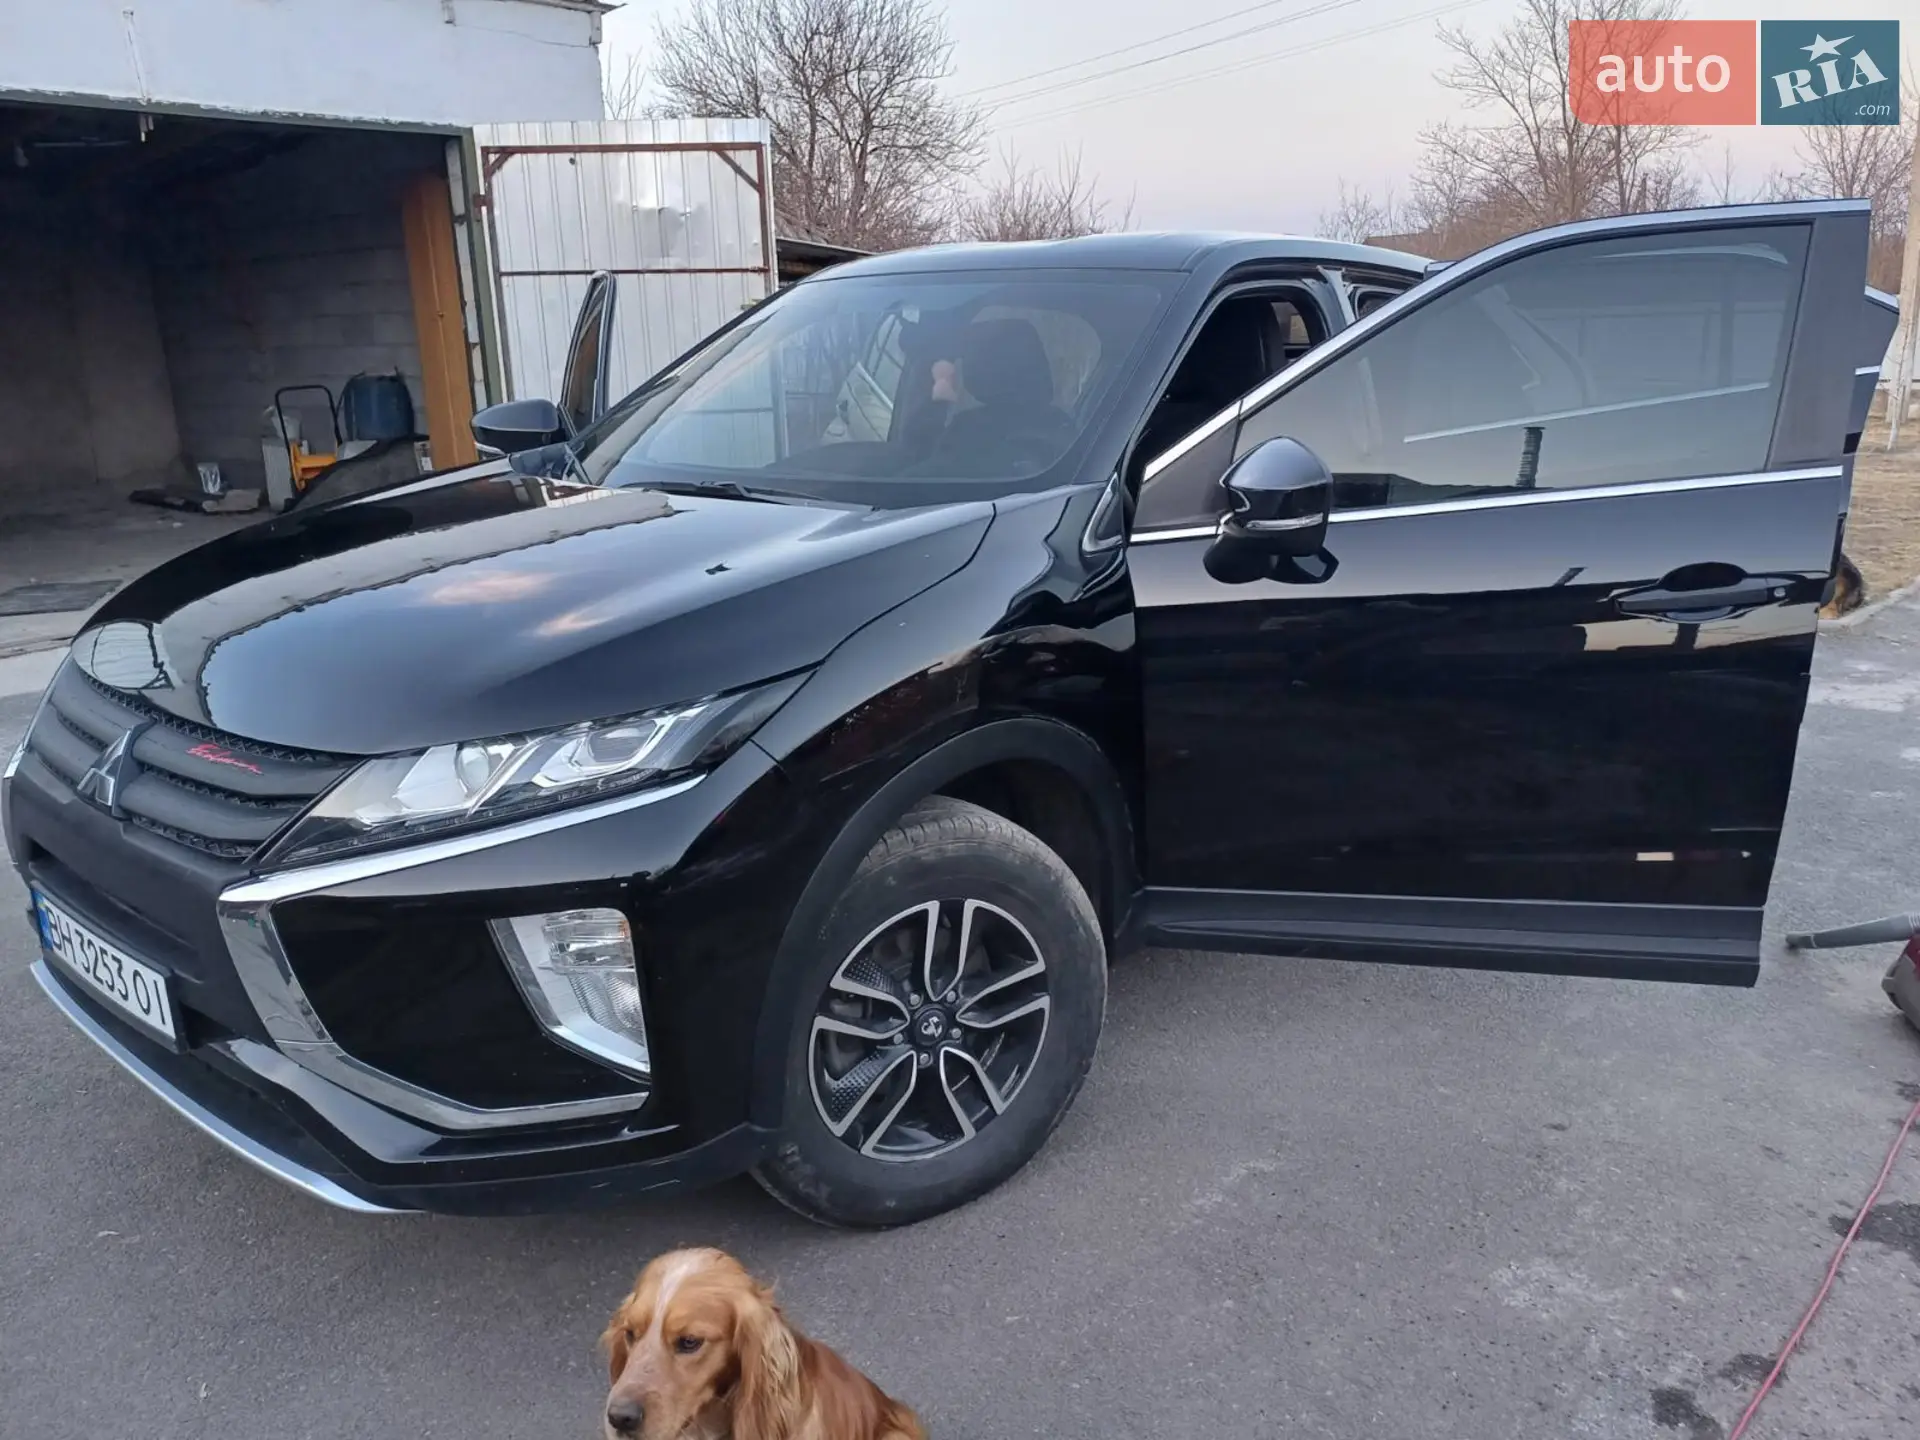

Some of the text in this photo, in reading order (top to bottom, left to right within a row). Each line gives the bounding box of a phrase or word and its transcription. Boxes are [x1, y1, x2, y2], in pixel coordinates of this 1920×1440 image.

[46, 906, 166, 1026] BH 3253 OI
